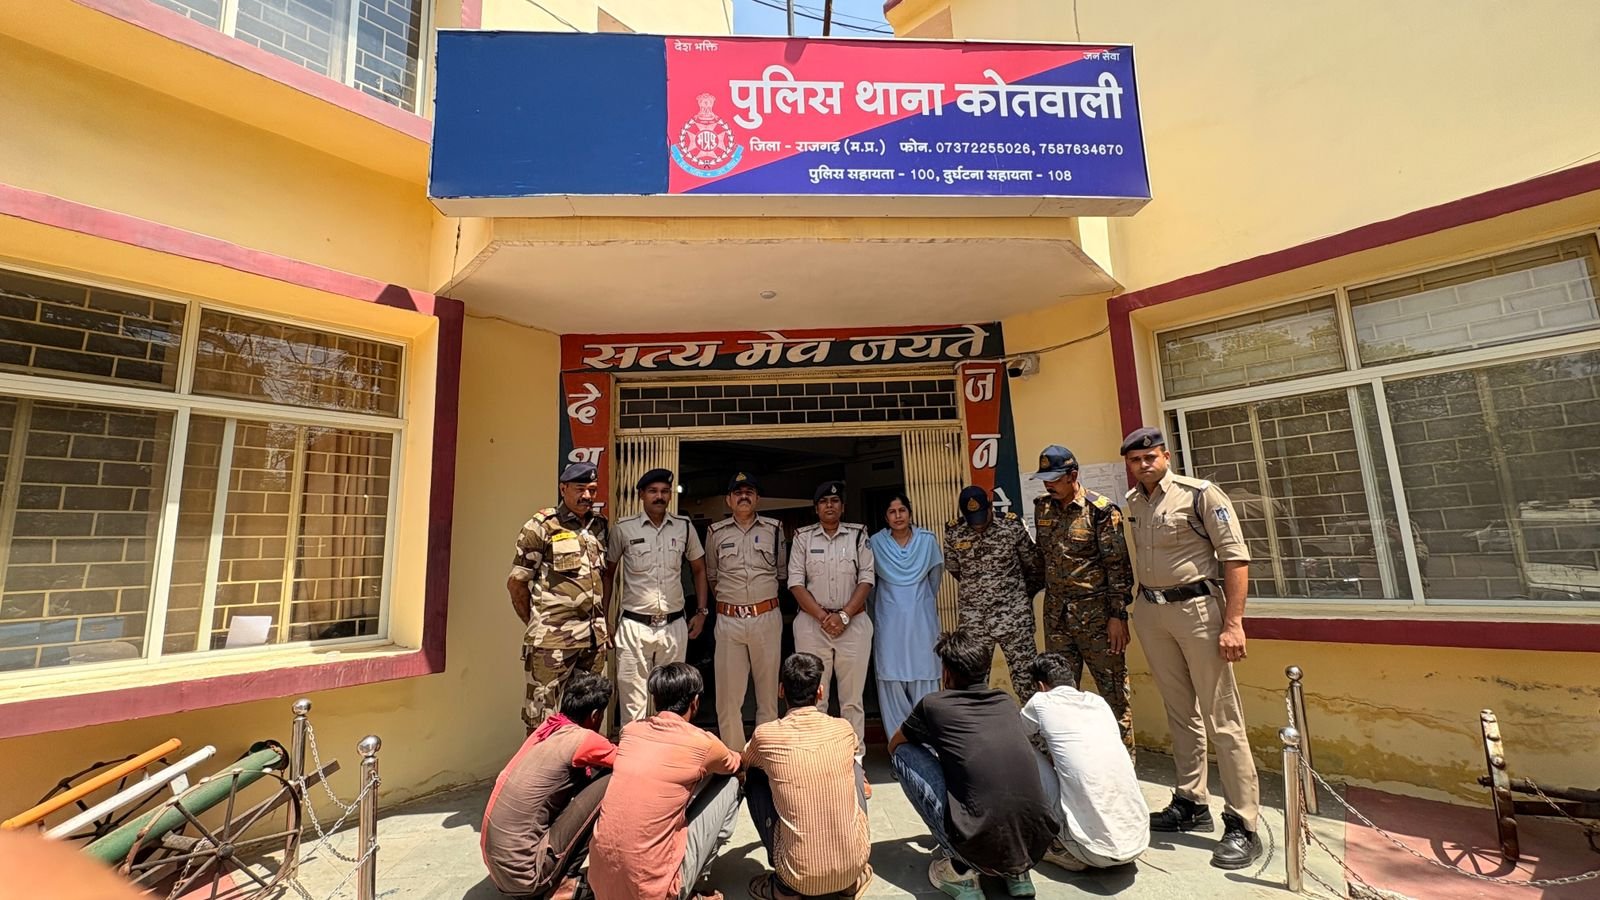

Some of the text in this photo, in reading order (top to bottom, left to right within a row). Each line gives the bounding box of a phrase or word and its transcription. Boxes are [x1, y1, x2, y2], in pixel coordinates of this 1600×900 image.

[673, 39, 719, 52] देश भक्ति
[1082, 49, 1120, 61] जन सेवा
[729, 65, 1123, 129] पुलिस थाना कोतवाली
[749, 136, 781, 152] जिला
[795, 141, 840, 155] राजगढ़
[844, 138, 886, 156] (म.प्र.)
[899, 138, 932, 153] फोन.
[808, 164, 845, 184] पुलिस
[847, 169, 895, 182] सहायता
[911, 169, 940, 182] 100,
[943, 165, 984, 185] दुर्घटना
[986, 169, 1033, 182] सहायता
[1048, 170, 1072, 181] 108
[584, 324, 990, 369] सत्य मेव जयते
